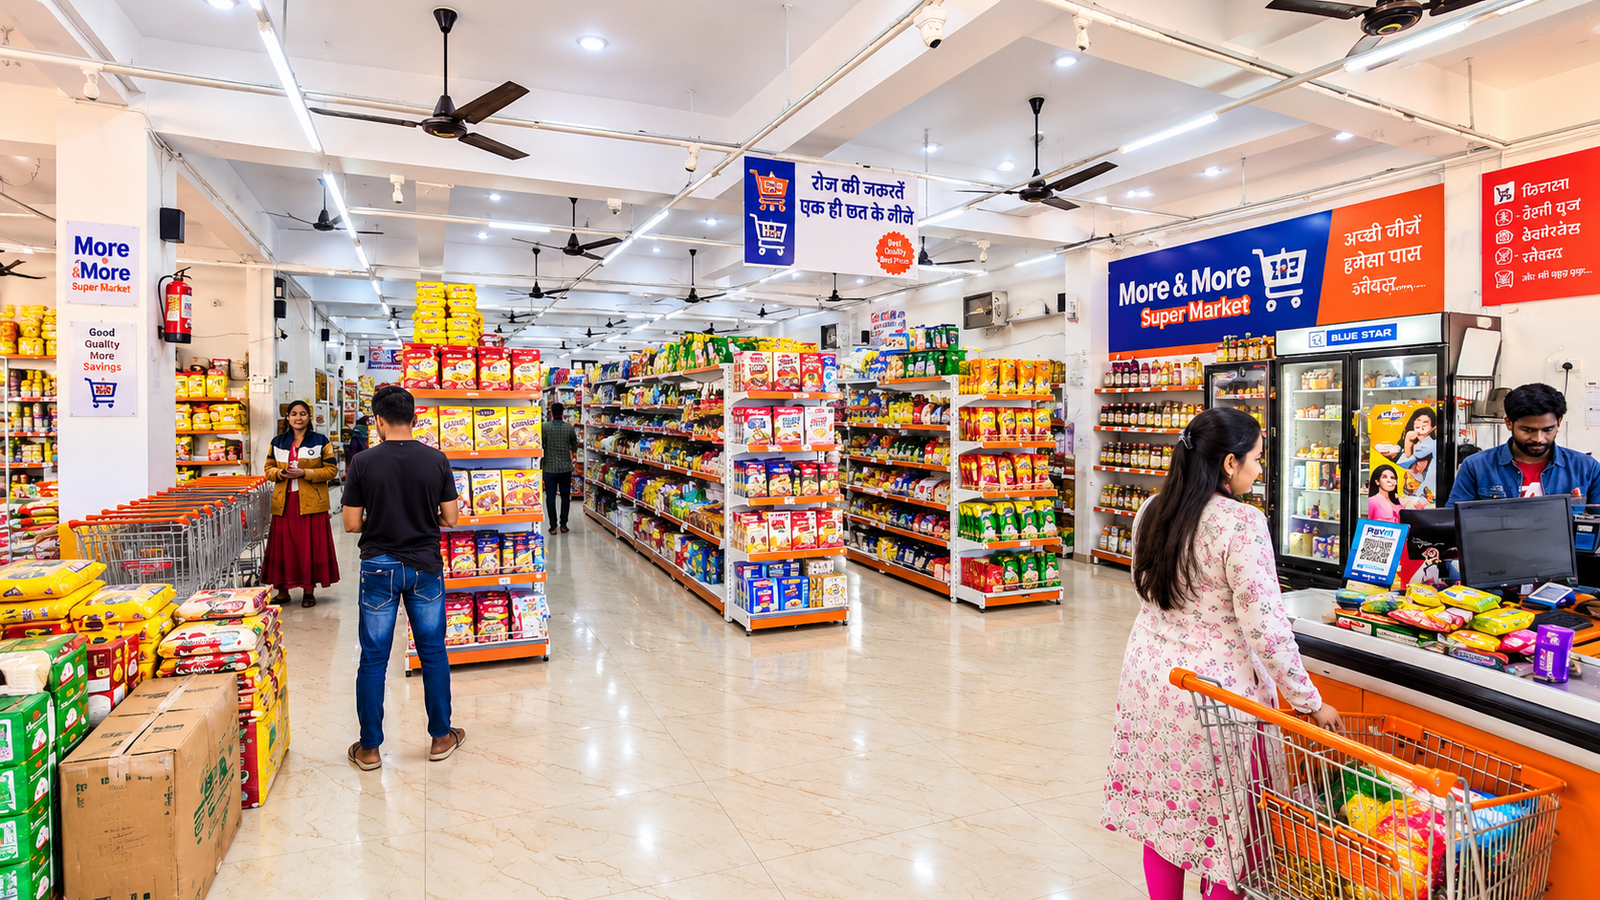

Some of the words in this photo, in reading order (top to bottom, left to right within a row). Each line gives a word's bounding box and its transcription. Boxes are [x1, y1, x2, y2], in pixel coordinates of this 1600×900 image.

[841, 174, 860, 195] की
[799, 199, 825, 218] एक
[827, 197, 843, 219] ही
[870, 202, 885, 221] के
[74, 235, 130, 258] More
[1388, 244, 1422, 264] पास
[72, 282, 99, 293] Super
[100, 283, 131, 293] Market
[1119, 280, 1170, 306] More
[1173, 272, 1188, 297] &
[1191, 266, 1251, 295] More
[1142, 308, 1186, 329] Super
[1189, 296, 1250, 321] Market
[89, 327, 115, 337] Good
[1331, 332, 1358, 342] BLUE
[1361, 328, 1392, 339] STAR
[90, 351, 115, 360] More
[83, 362, 122, 373] Savings
